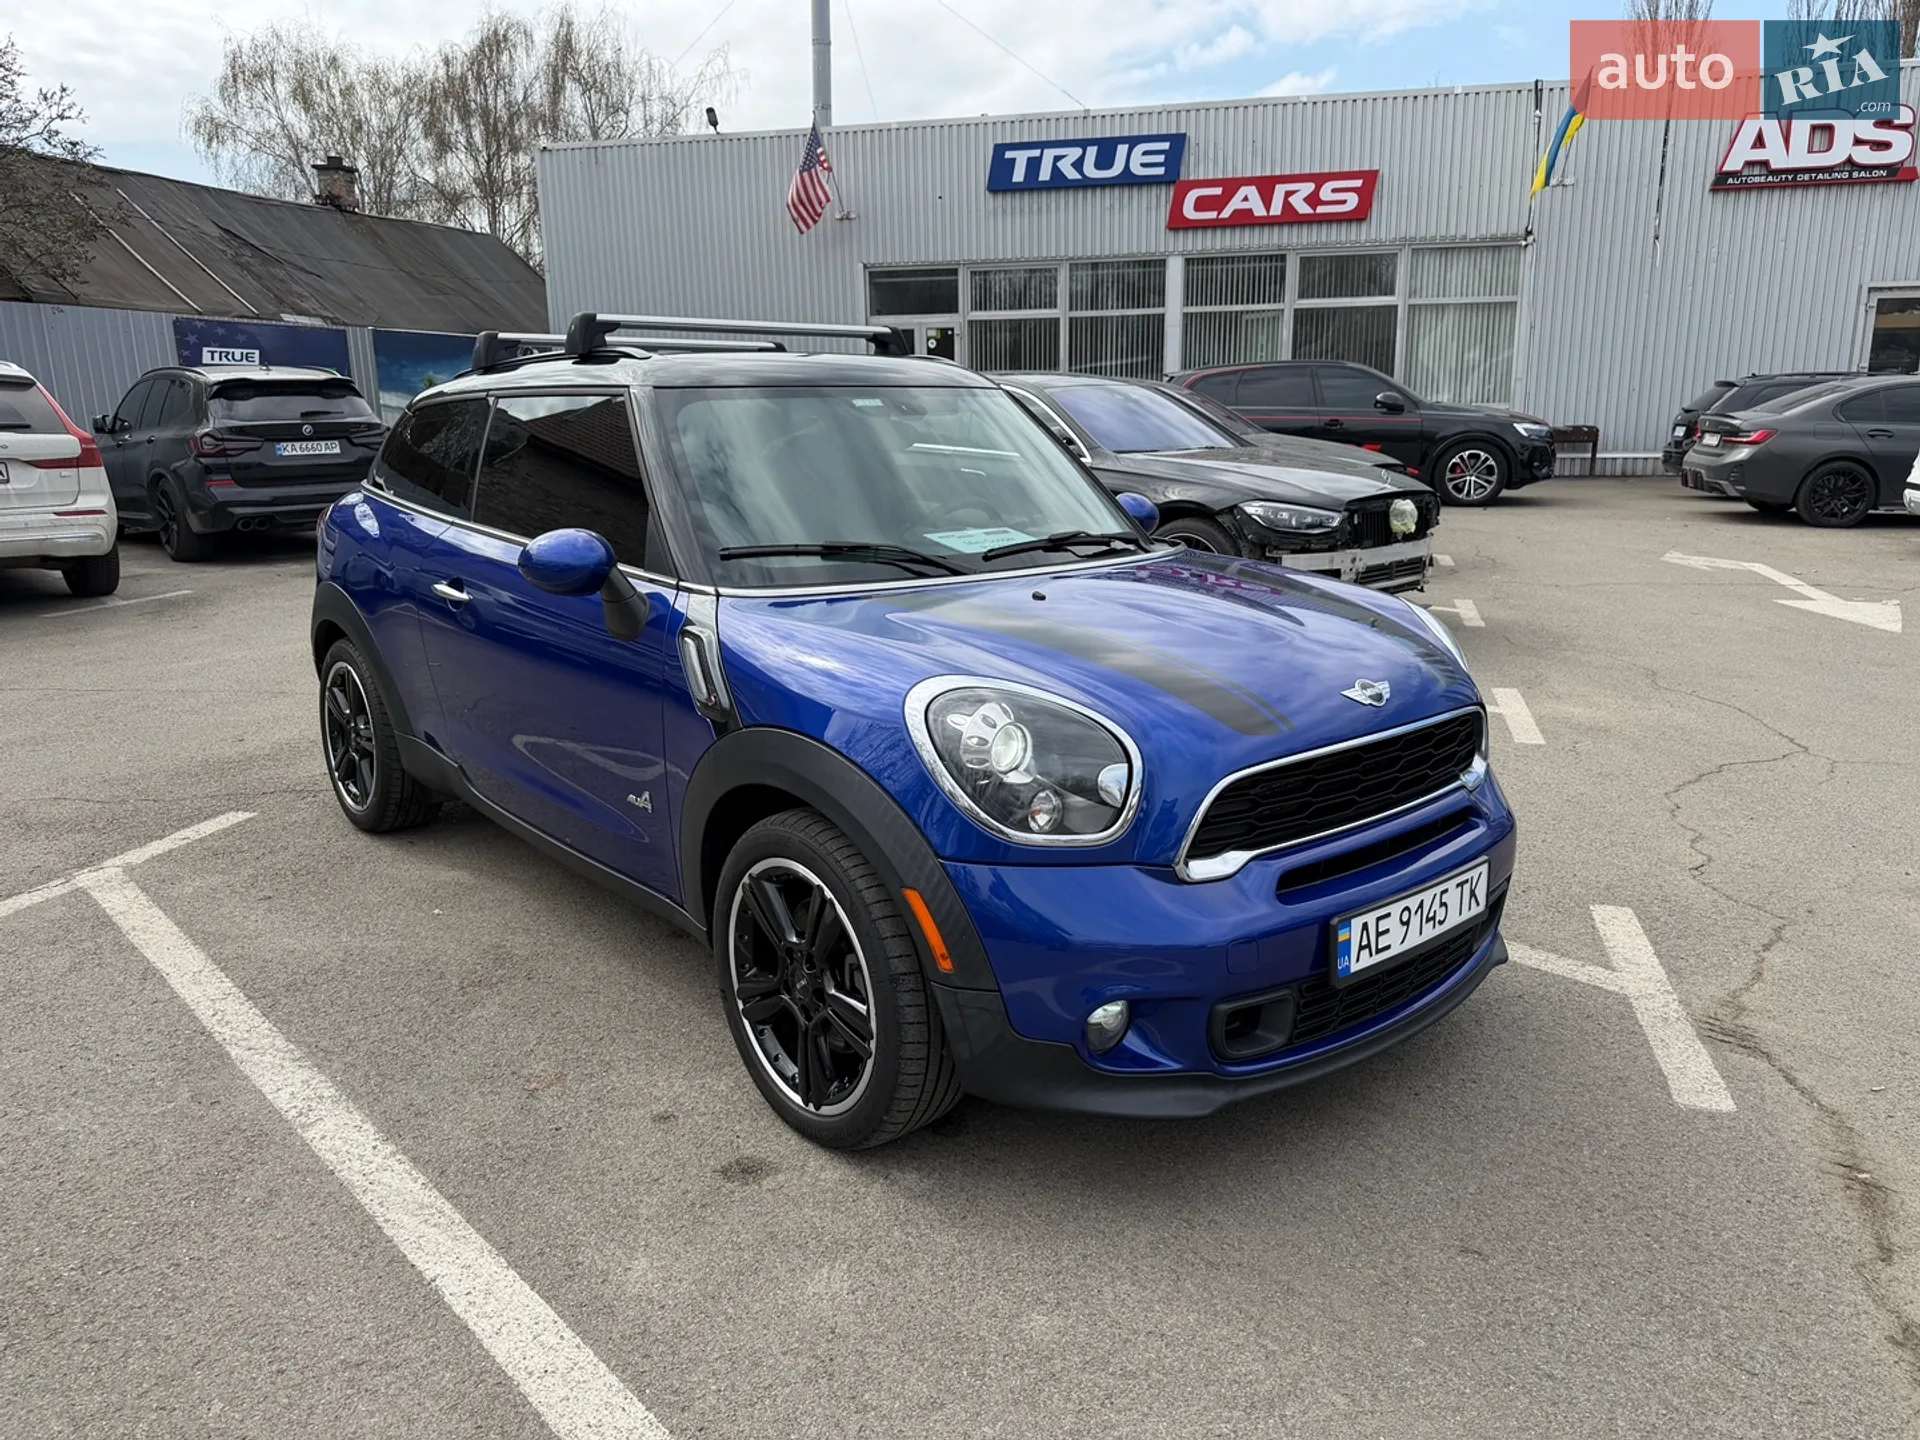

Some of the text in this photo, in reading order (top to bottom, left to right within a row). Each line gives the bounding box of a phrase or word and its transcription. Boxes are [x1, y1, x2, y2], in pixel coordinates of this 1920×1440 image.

[1719, 104, 1915, 173] ADS
[1004, 140, 1171, 183] TRUE
[1726, 169, 1887, 184] AUTOBEAUTY DETAILING SALON
[1182, 178, 1363, 220] CARS
[206, 349, 256, 363] TRUE
[1356, 871, 1483, 964] AE 9145 TK
[1337, 955, 1350, 969] UA
